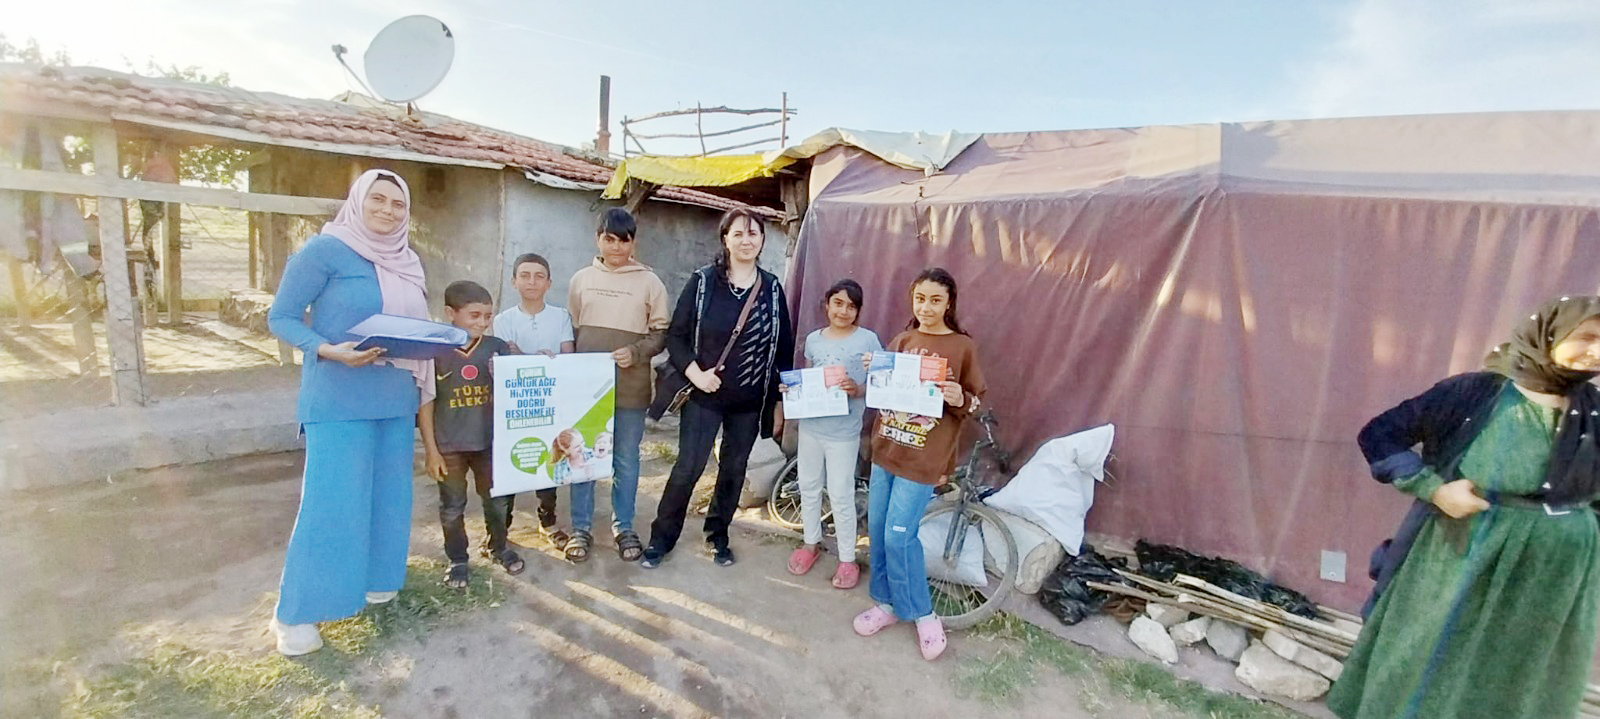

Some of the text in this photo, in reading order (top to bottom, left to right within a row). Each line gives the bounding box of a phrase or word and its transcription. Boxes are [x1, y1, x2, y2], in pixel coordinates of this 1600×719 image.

[505, 376, 556, 388] GÜNLÜK AĞIZ
[453, 385, 489, 397] TÜRK
[542, 387, 552, 396] VE
[517, 397, 546, 408] DOĞRU
[505, 408, 544, 418] BESLENME
